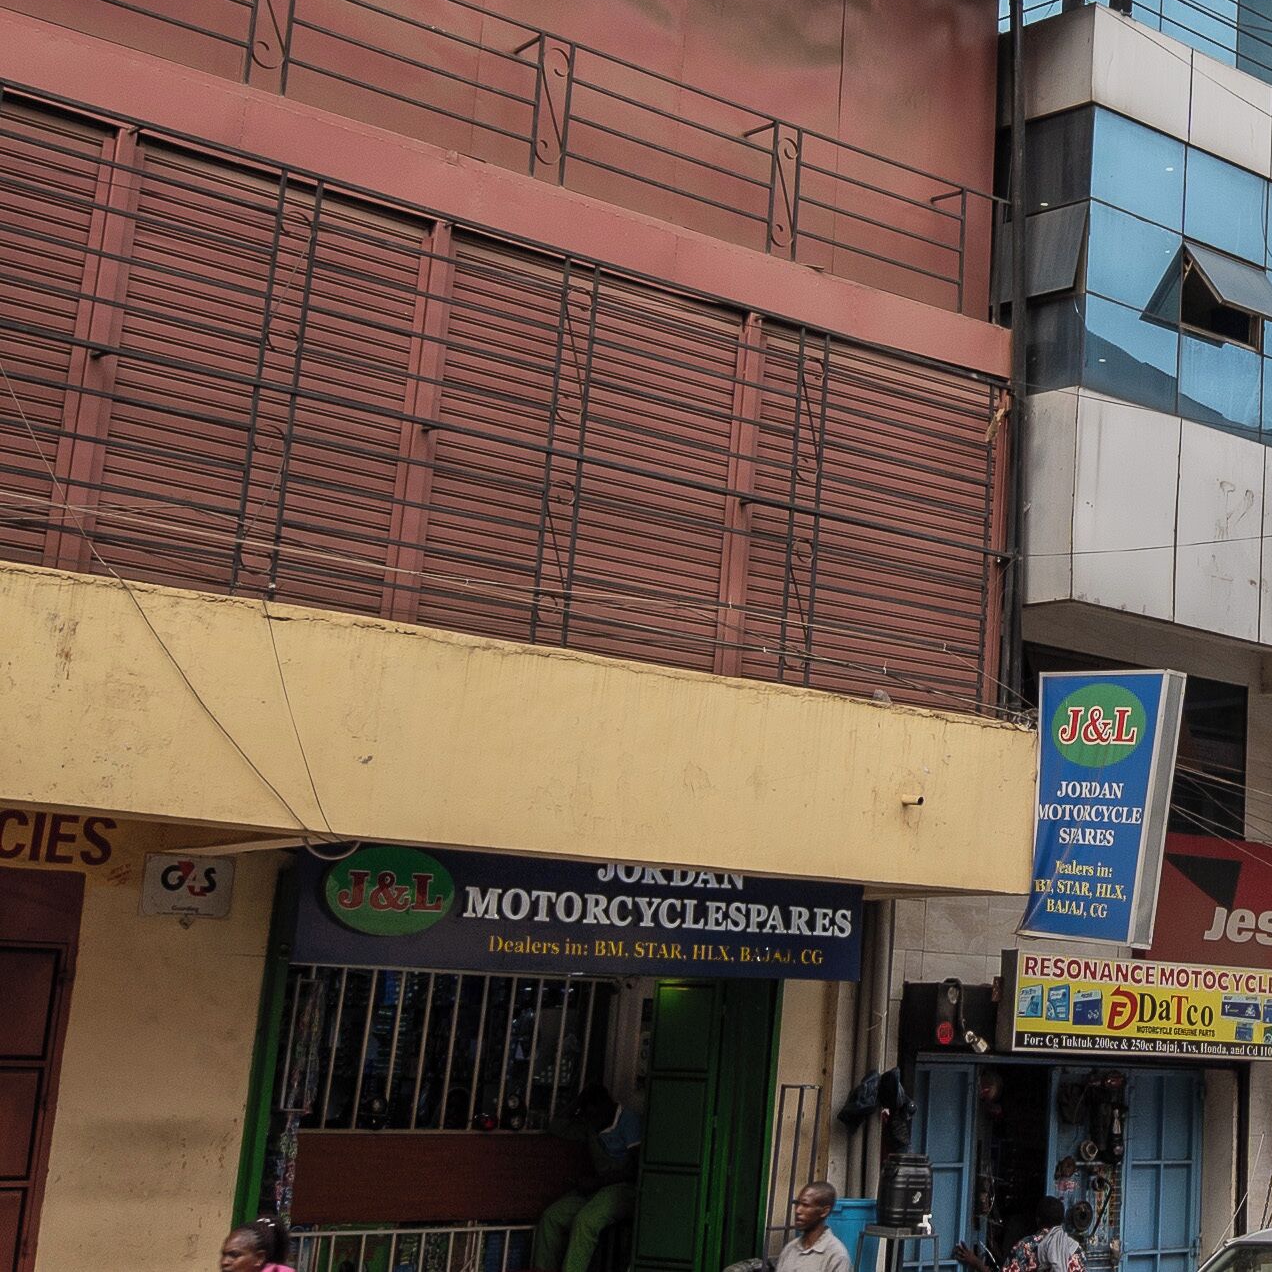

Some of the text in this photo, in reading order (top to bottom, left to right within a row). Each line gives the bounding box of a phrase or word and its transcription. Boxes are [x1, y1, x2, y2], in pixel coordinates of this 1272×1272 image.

[1058, 705, 1138, 746] J&L
[1056, 781, 1125, 799] JORDAN
[1037, 803, 1143, 825] MOTORCYCLE
[1058, 827, 1115, 847] SPARES
[337, 869, 444, 913] J&L
[1056, 879, 1093, 899] STAR,
[488, 934, 560, 956] Dealers
[564, 937, 588, 957] in:
[800, 949, 824, 965] CG
[1024, 956, 1156, 986] RESONANCE
[1136, 1026, 1173, 1036] MOTORCYCLE
[1198, 1029, 1216, 1038] PARTS
[1023, 1033, 1044, 1046] For:
[1045, 1035, 1059, 1049] Cg
[1060, 1034, 1094, 1049] Tuktuk
[1094, 1037, 1119, 1050] 200cc
[1119, 1039, 1129, 1050] &
[1130, 1039, 1155, 1051] 250cc
[1229, 1044, 1245, 1056] and
